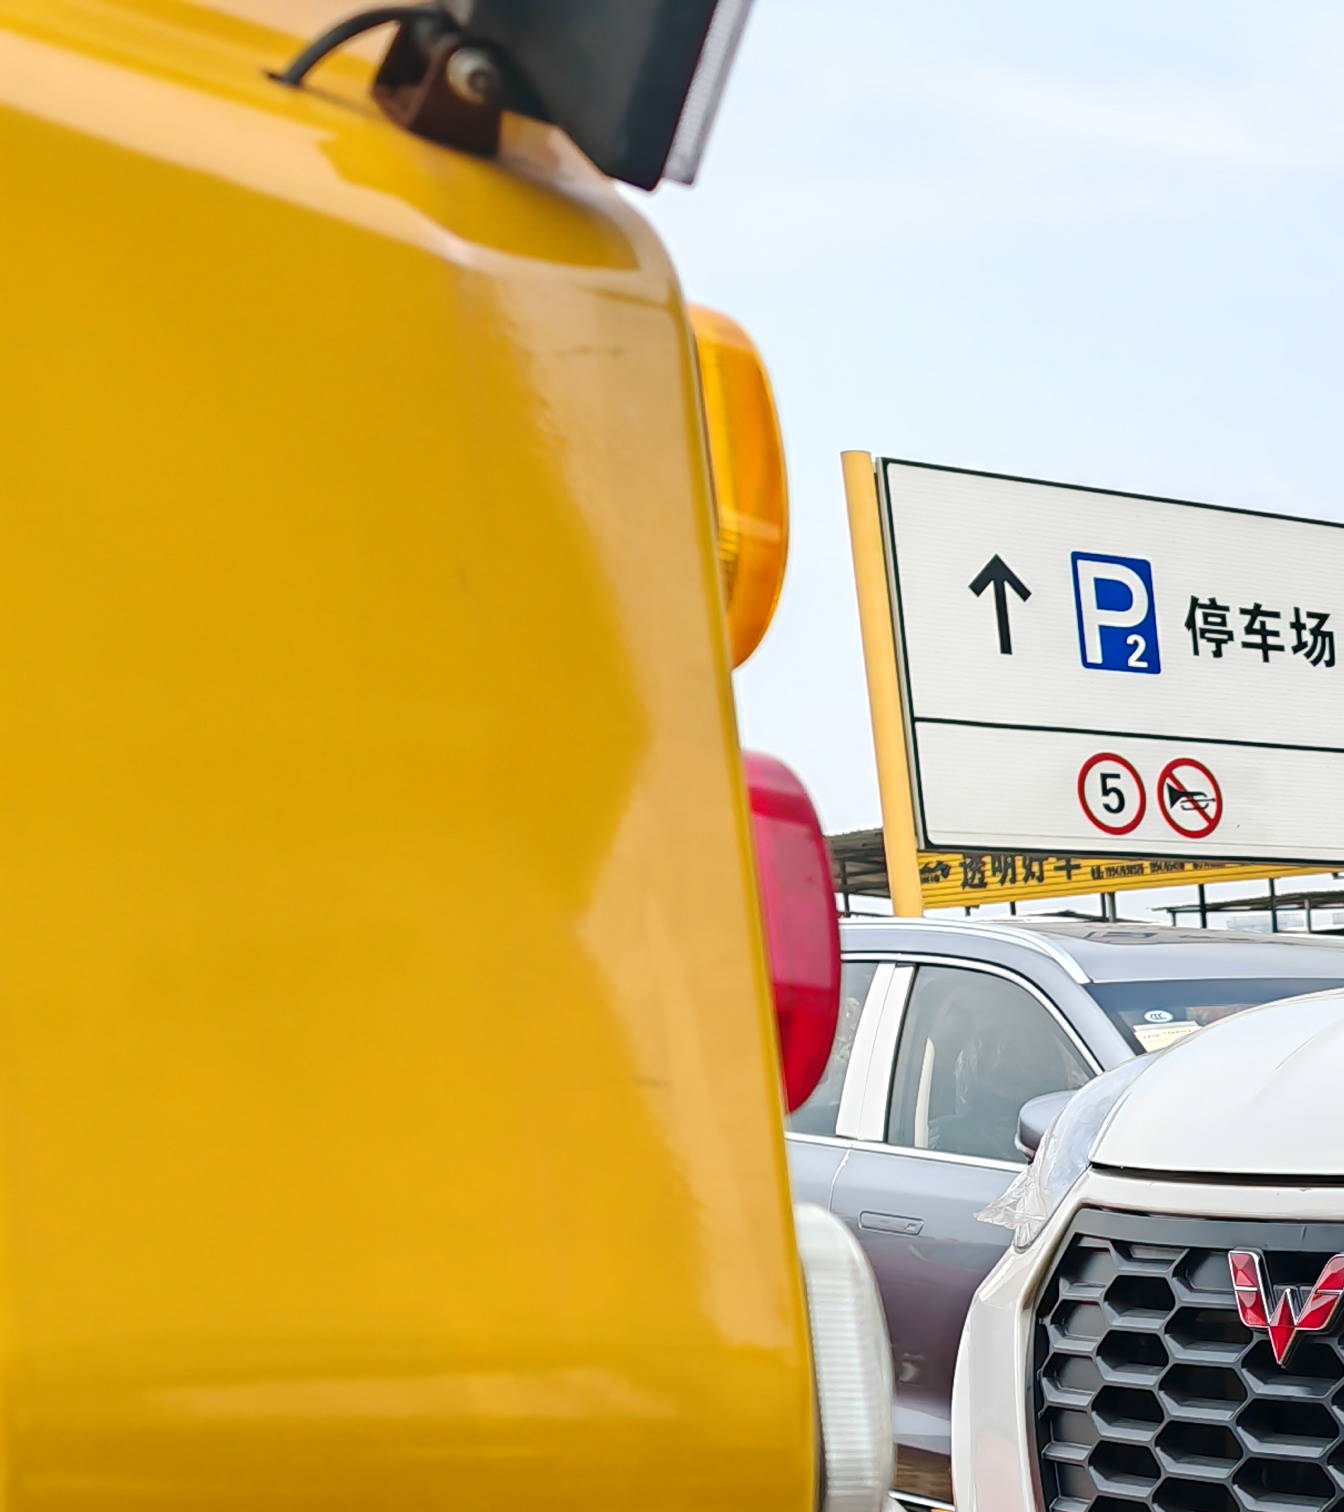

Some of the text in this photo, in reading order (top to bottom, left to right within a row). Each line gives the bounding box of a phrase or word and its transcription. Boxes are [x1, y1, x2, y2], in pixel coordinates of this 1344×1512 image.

[1183, 594, 1337, 670] 停车场
[1101, 772, 1126, 815] 5
